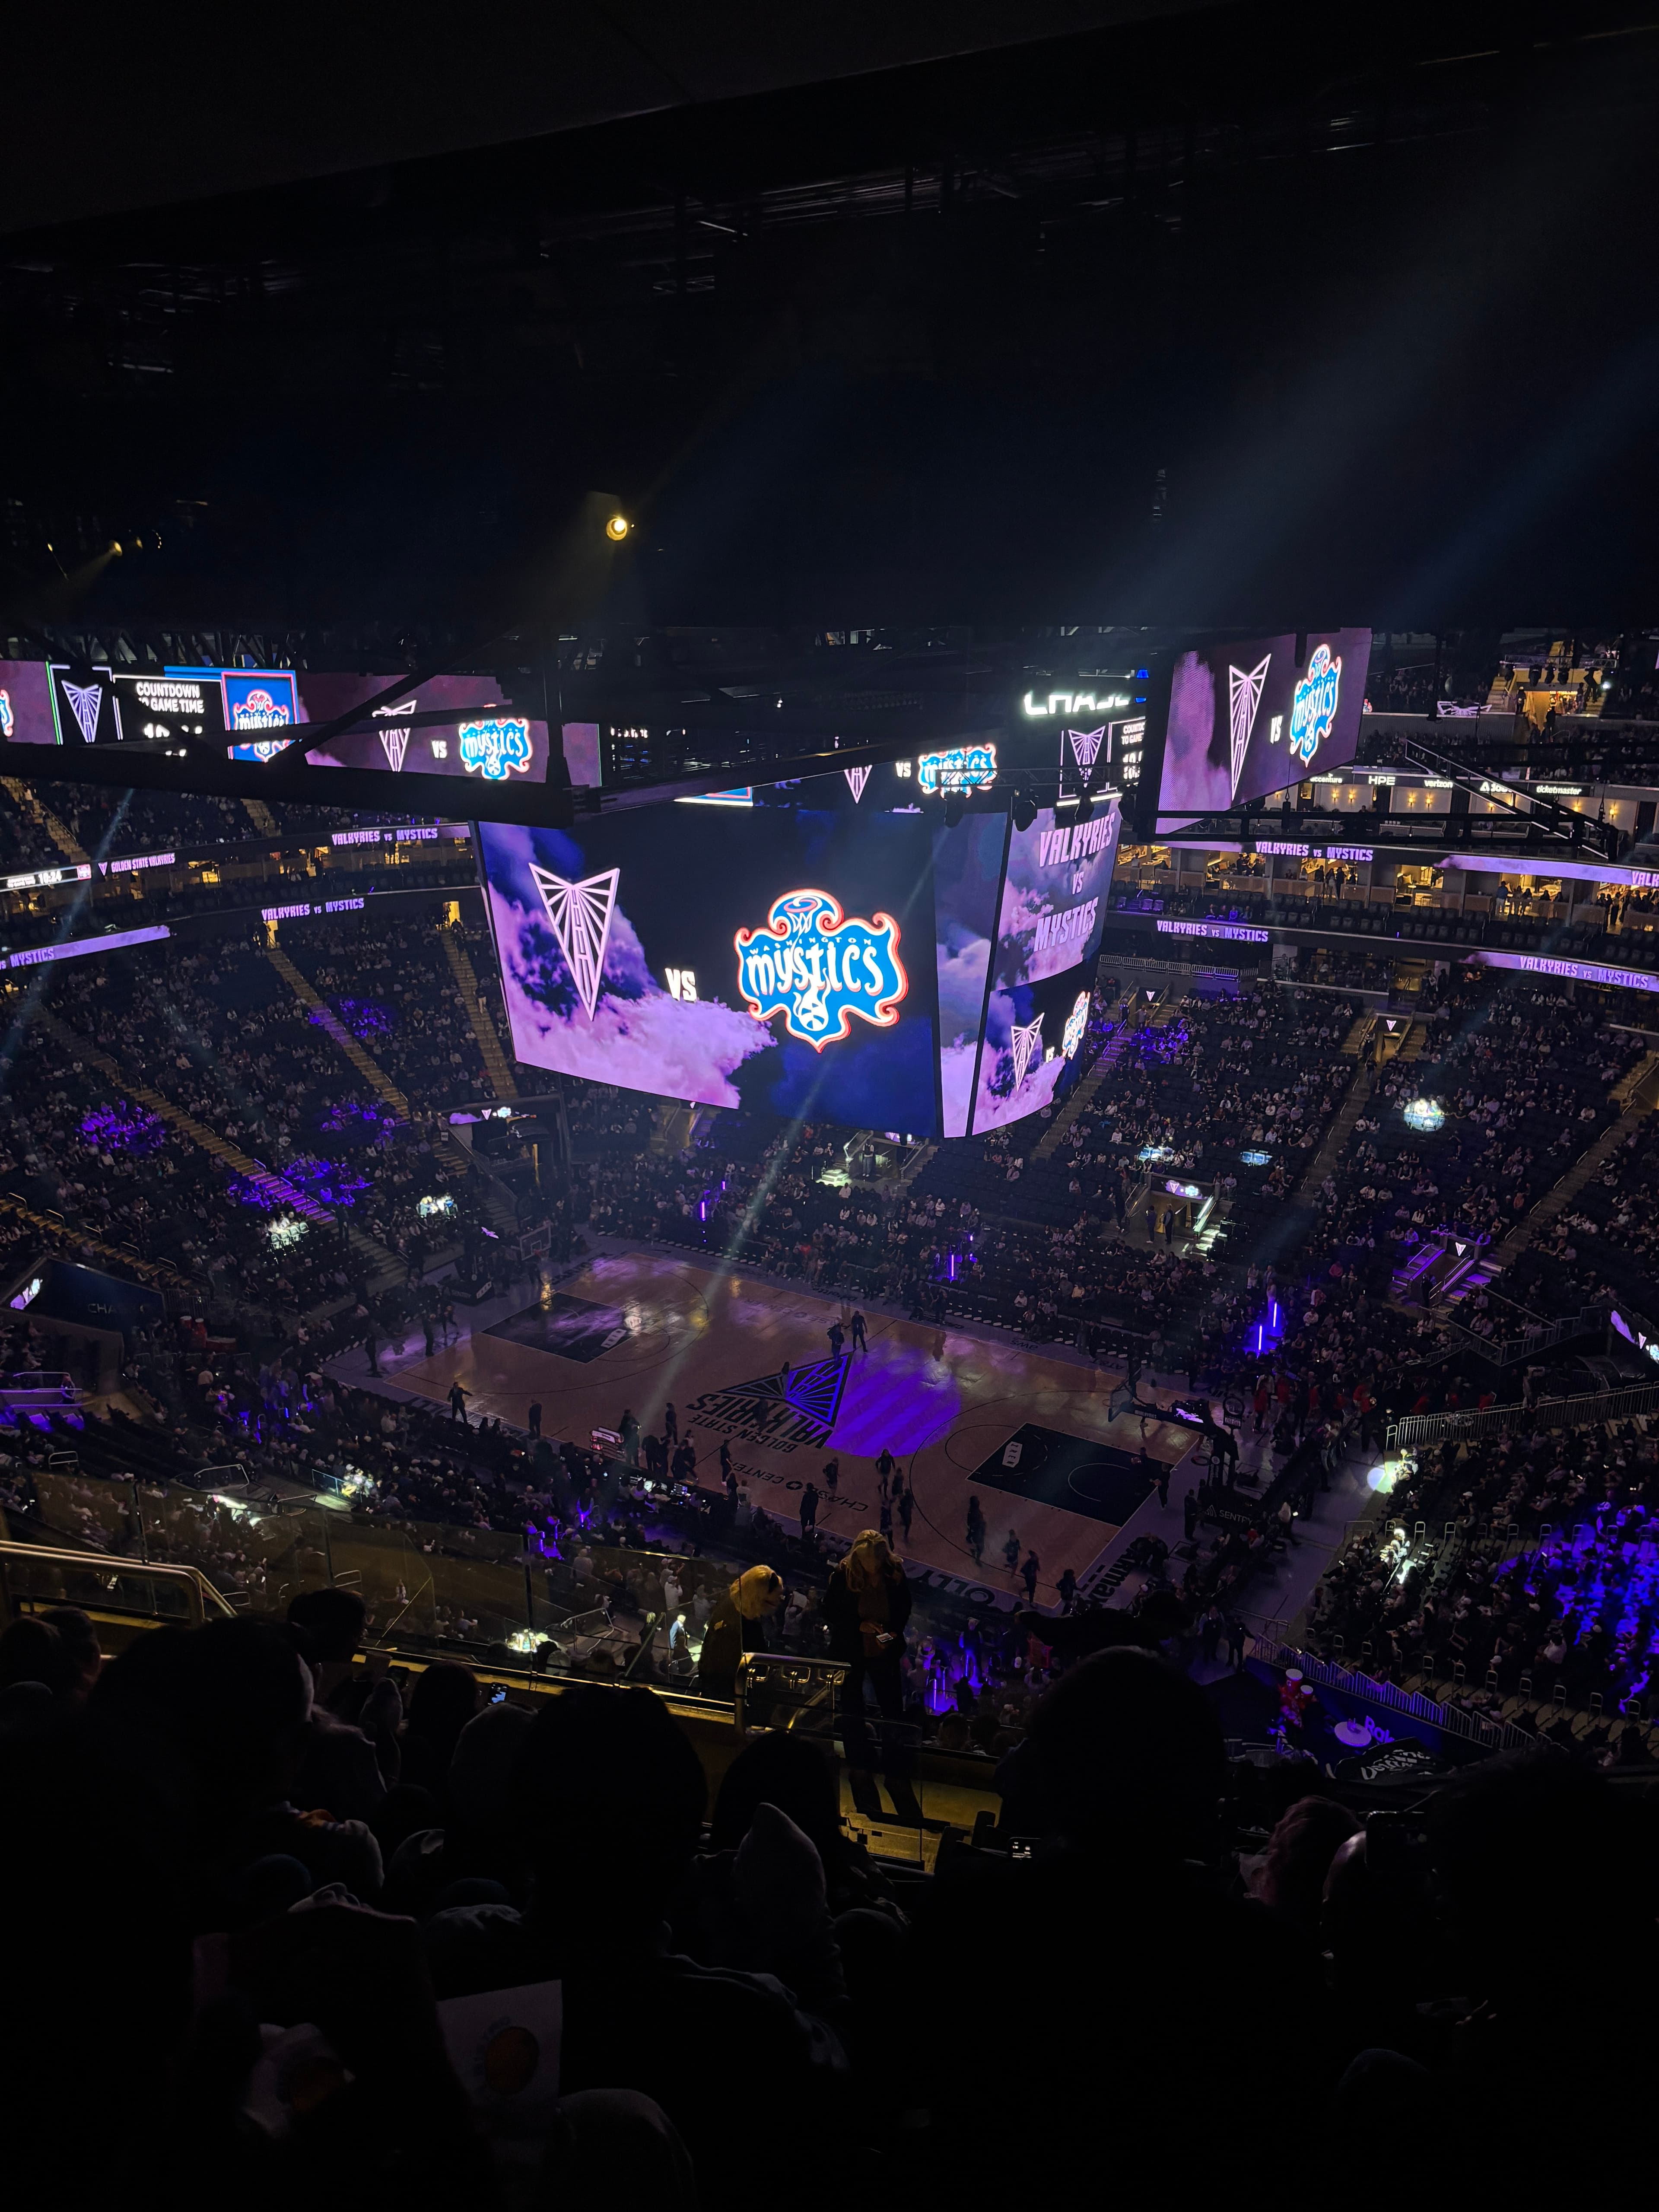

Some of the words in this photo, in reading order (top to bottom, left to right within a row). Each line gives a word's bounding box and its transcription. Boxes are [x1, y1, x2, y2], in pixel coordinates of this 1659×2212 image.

[137, 681, 200, 698] COUNTDOWN
[151, 698, 179, 712] GAME
[179, 699, 205, 713] TIME
[1295, 681, 1334, 733] mystics
[464, 730, 524, 758] mystics
[1369, 775, 1396, 785] HPE
[1424, 779, 1453, 788] verizon
[1536, 785, 1582, 795] ticketmaster
[332, 830, 381, 846] VALKYRIES
[397, 828, 438, 841] MYSTICS
[1039, 812, 1116, 868] VALKYRIES
[1255, 841, 1309, 856] VALKYRIES
[1327, 847, 1373, 861] MYSTICS
[111, 858, 131, 873] GOLDEN
[131, 857, 149, 870] STATE
[149, 852, 176, 868] VALKYRIES
[38, 871, 63, 884] 10:24
[261, 903, 310, 921] VALKYRIES
[325, 897, 365, 913] MYSTICS
[1033, 896, 1099, 953] MYSTICS
[1157, 920, 1208, 936] VALKYRIES
[1224, 927, 1268, 942] MYSTICS
[750, 937, 872, 955] WASHINGTON
[10, 947, 55, 968] MYSTICS
[745, 942, 884, 997] mystics
[1519, 956, 1578, 977] VALKYRIES
[1599, 969, 1649, 988] MYSTICS
[1009, 1340, 1039, 1351] aws
[686, 1393, 833, 1449] VALKRIES
[689, 1414, 737, 1434] STATE
[1220, 1510, 1253, 1525] SENTRY
